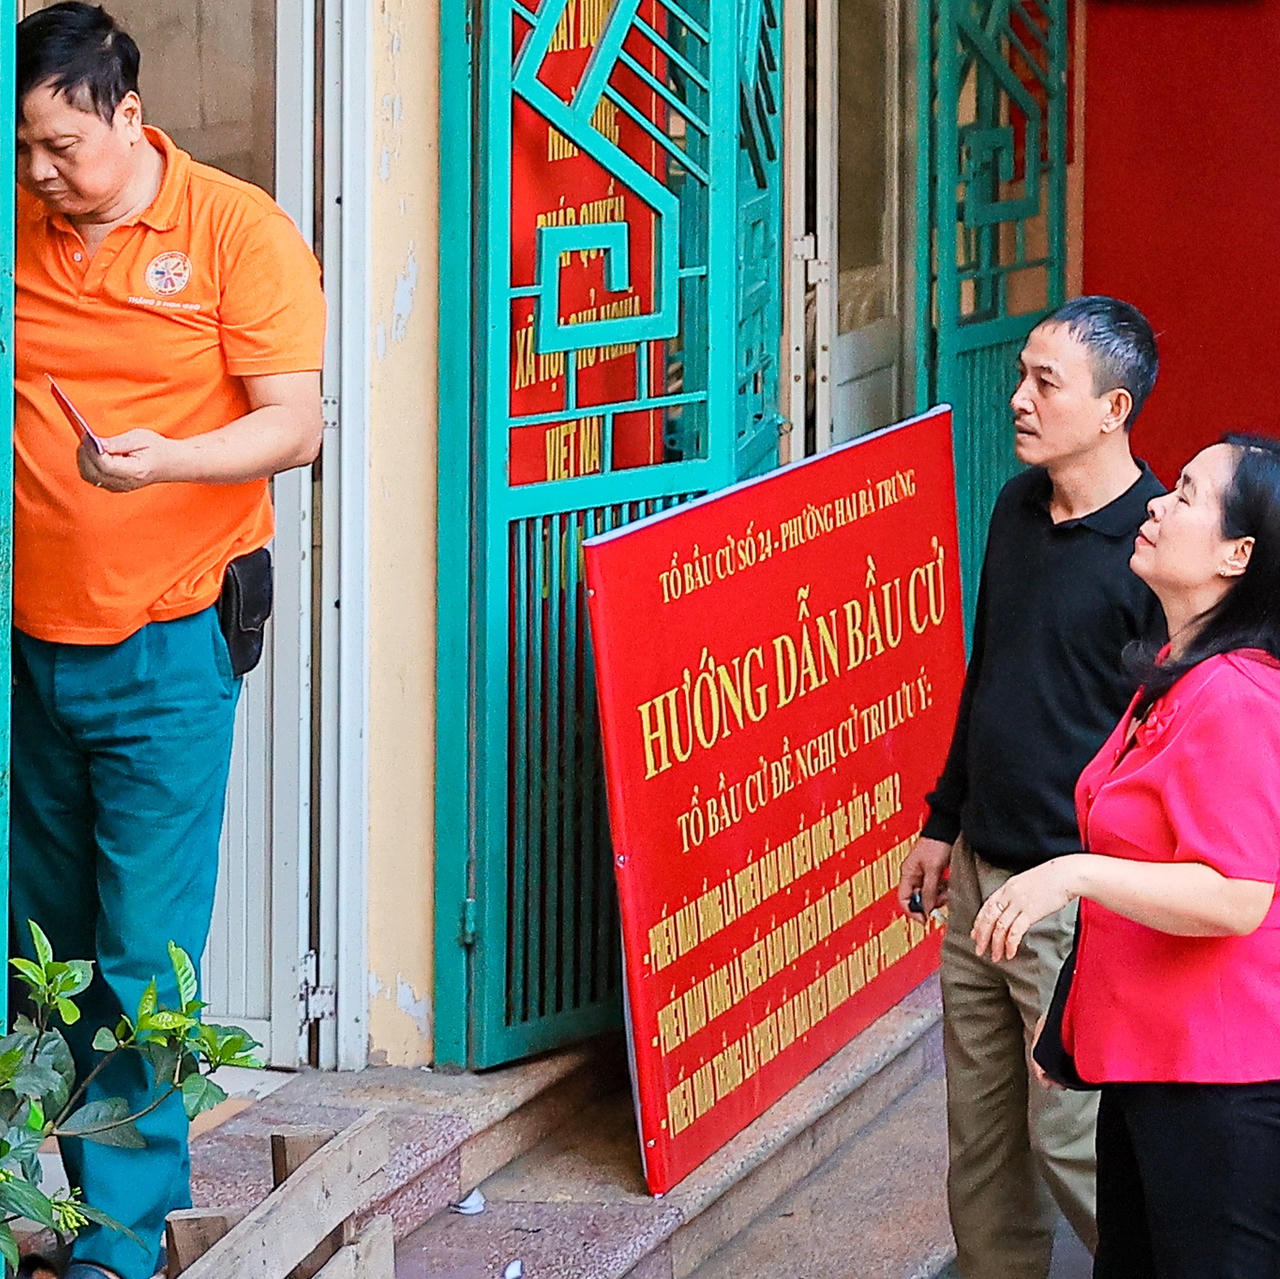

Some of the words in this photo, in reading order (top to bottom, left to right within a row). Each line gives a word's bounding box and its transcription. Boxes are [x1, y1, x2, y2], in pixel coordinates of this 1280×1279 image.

[569, 287, 597, 370] HỦ
[579, 417, 601, 477] NA
[659, 552, 683, 604] TỔ
[683, 544, 713, 595] BẦU
[715, 534, 736, 581] CỬ
[736, 520, 757, 571] SỐ
[757, 529, 773, 562] 24
[780, 503, 834, 552] PHƯỜNG
[834, 491, 858, 528] HAI
[858, 479, 876, 519] BÀ
[876, 469, 917, 510] TRƯNG
[637, 647, 769, 781] HƯỚNG
[772, 584, 841, 709] DẪN
[842, 554, 903, 672] BẦU
[907, 535, 947, 635] CỬ
[677, 785, 704, 854] TỔ
[706, 771, 743, 839] BẦU
[745, 755, 770, 814] CỬ
[770, 735, 796, 800] ĐỀ
[795, 728, 838, 785] NGHỊ
[838, 703, 860, 759] CỬ
[860, 694, 888, 745] TRI
[887, 681, 916, 732] LƯU
